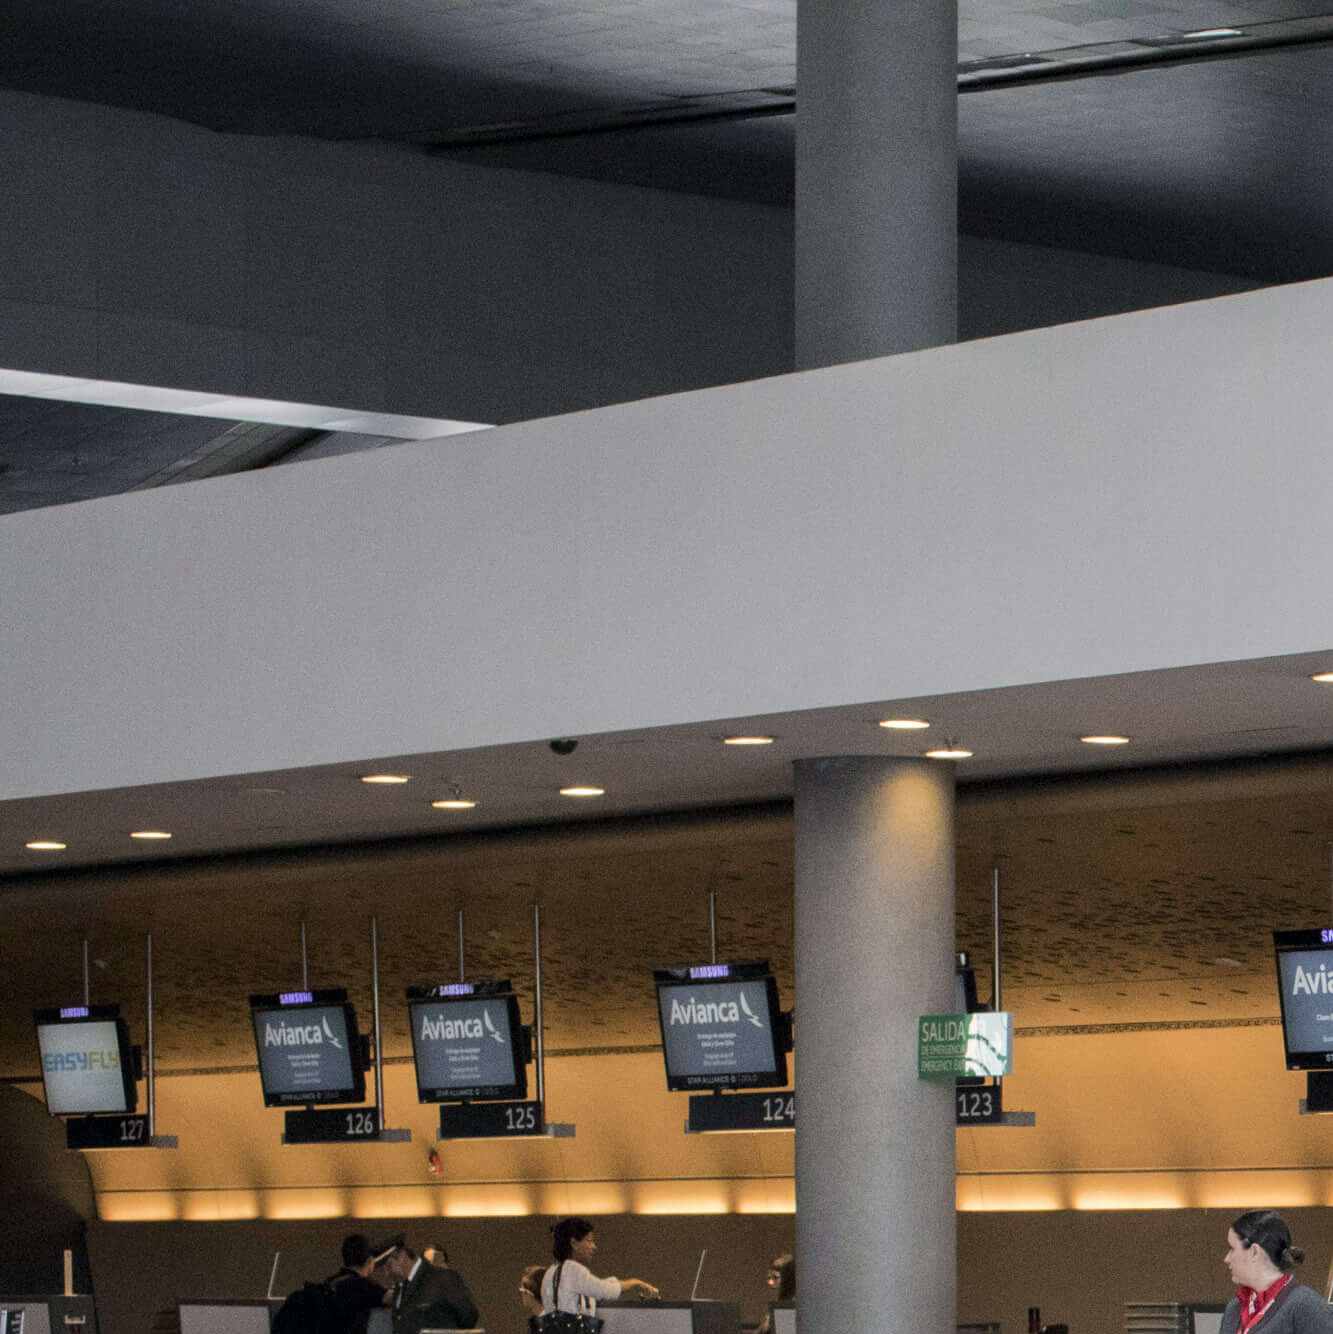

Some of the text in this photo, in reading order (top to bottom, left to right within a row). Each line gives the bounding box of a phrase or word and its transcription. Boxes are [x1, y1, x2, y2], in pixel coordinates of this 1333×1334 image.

[670, 997, 740, 1025] Avianca
[265, 1021, 322, 1047] Avianca
[421, 1015, 483, 1040] Avianca
[922, 1022, 966, 1042] SALIDA
[43, 1050, 120, 1072] EASYFLY
[763, 1097, 795, 1121] 124
[959, 1093, 992, 1117] 123
[120, 1120, 144, 1140] 127
[346, 1113, 373, 1134] 126
[506, 1108, 535, 1129] 125
